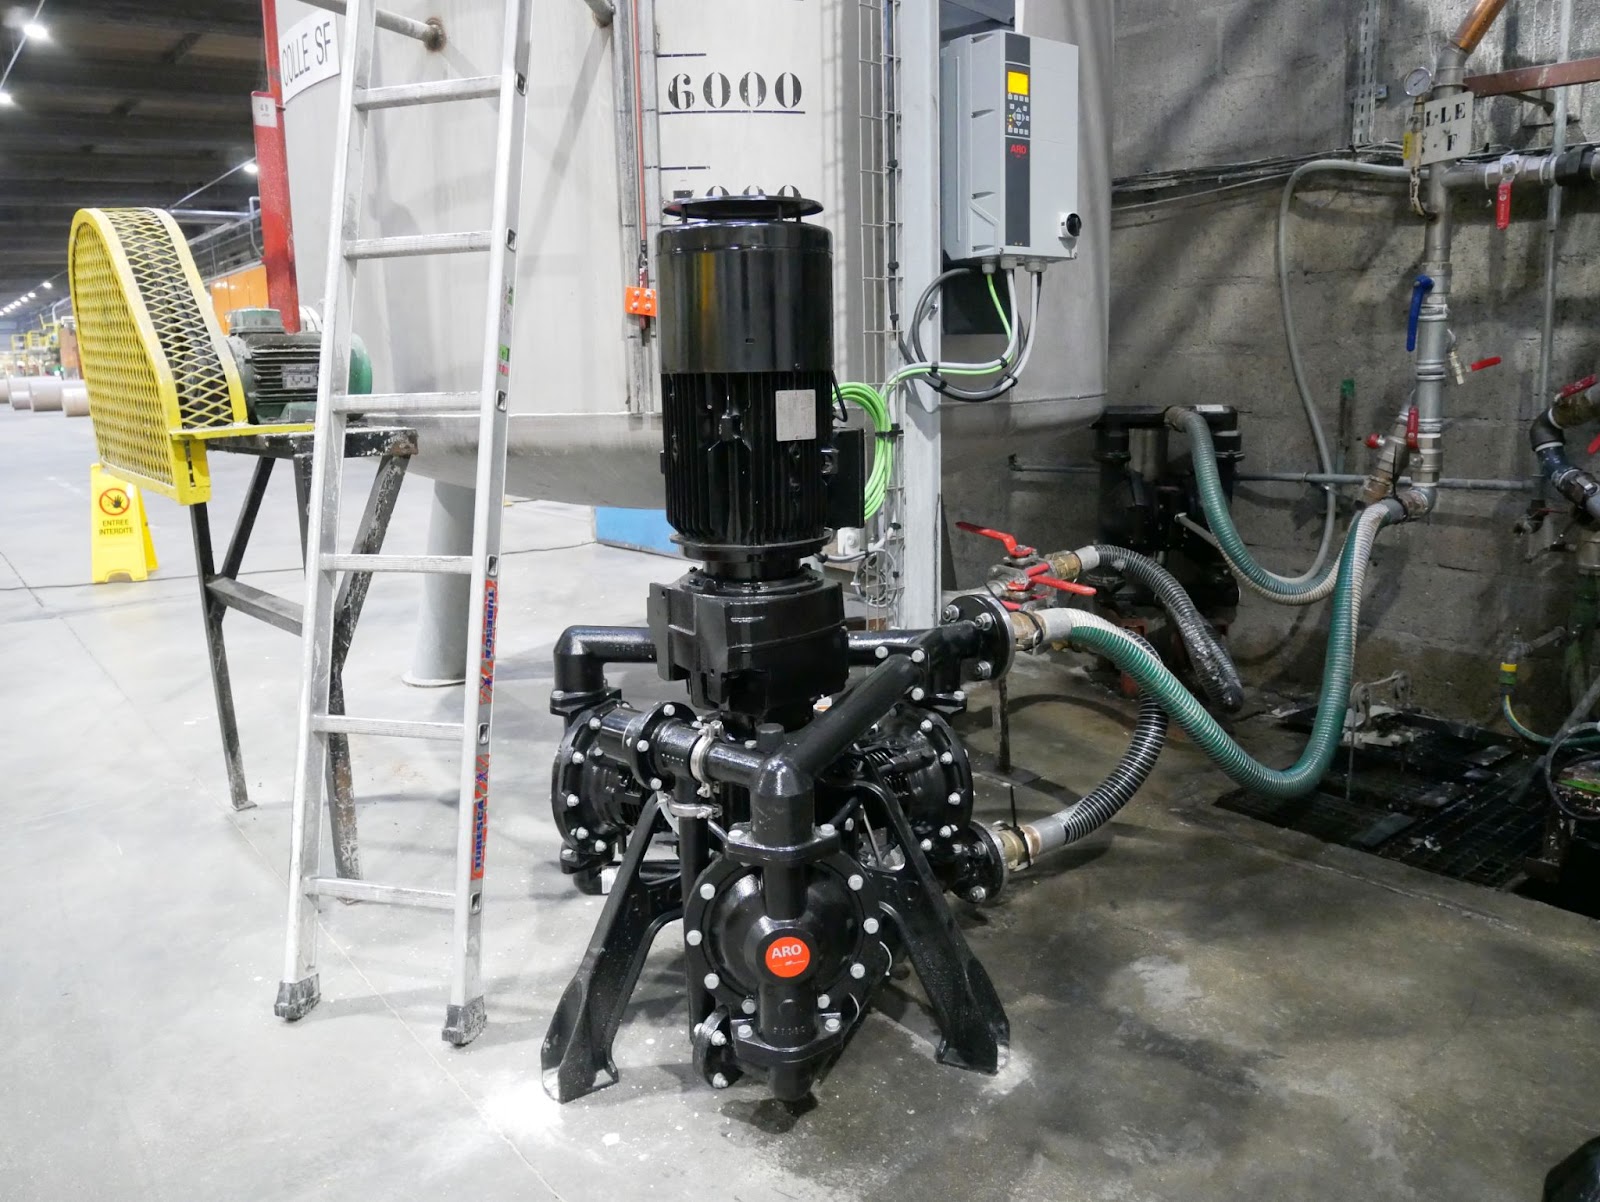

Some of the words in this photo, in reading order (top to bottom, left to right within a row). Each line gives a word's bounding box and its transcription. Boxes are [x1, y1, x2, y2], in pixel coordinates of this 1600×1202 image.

[282, 32, 310, 87] COLLE
[314, 21, 331, 65] SF
[668, 71, 802, 110] 6000
[1010, 144, 1027, 154] ARO
[99, 527, 133, 535] INTERDITE
[475, 799, 484, 869] TUBESCA
[771, 944, 802, 959] ARO
